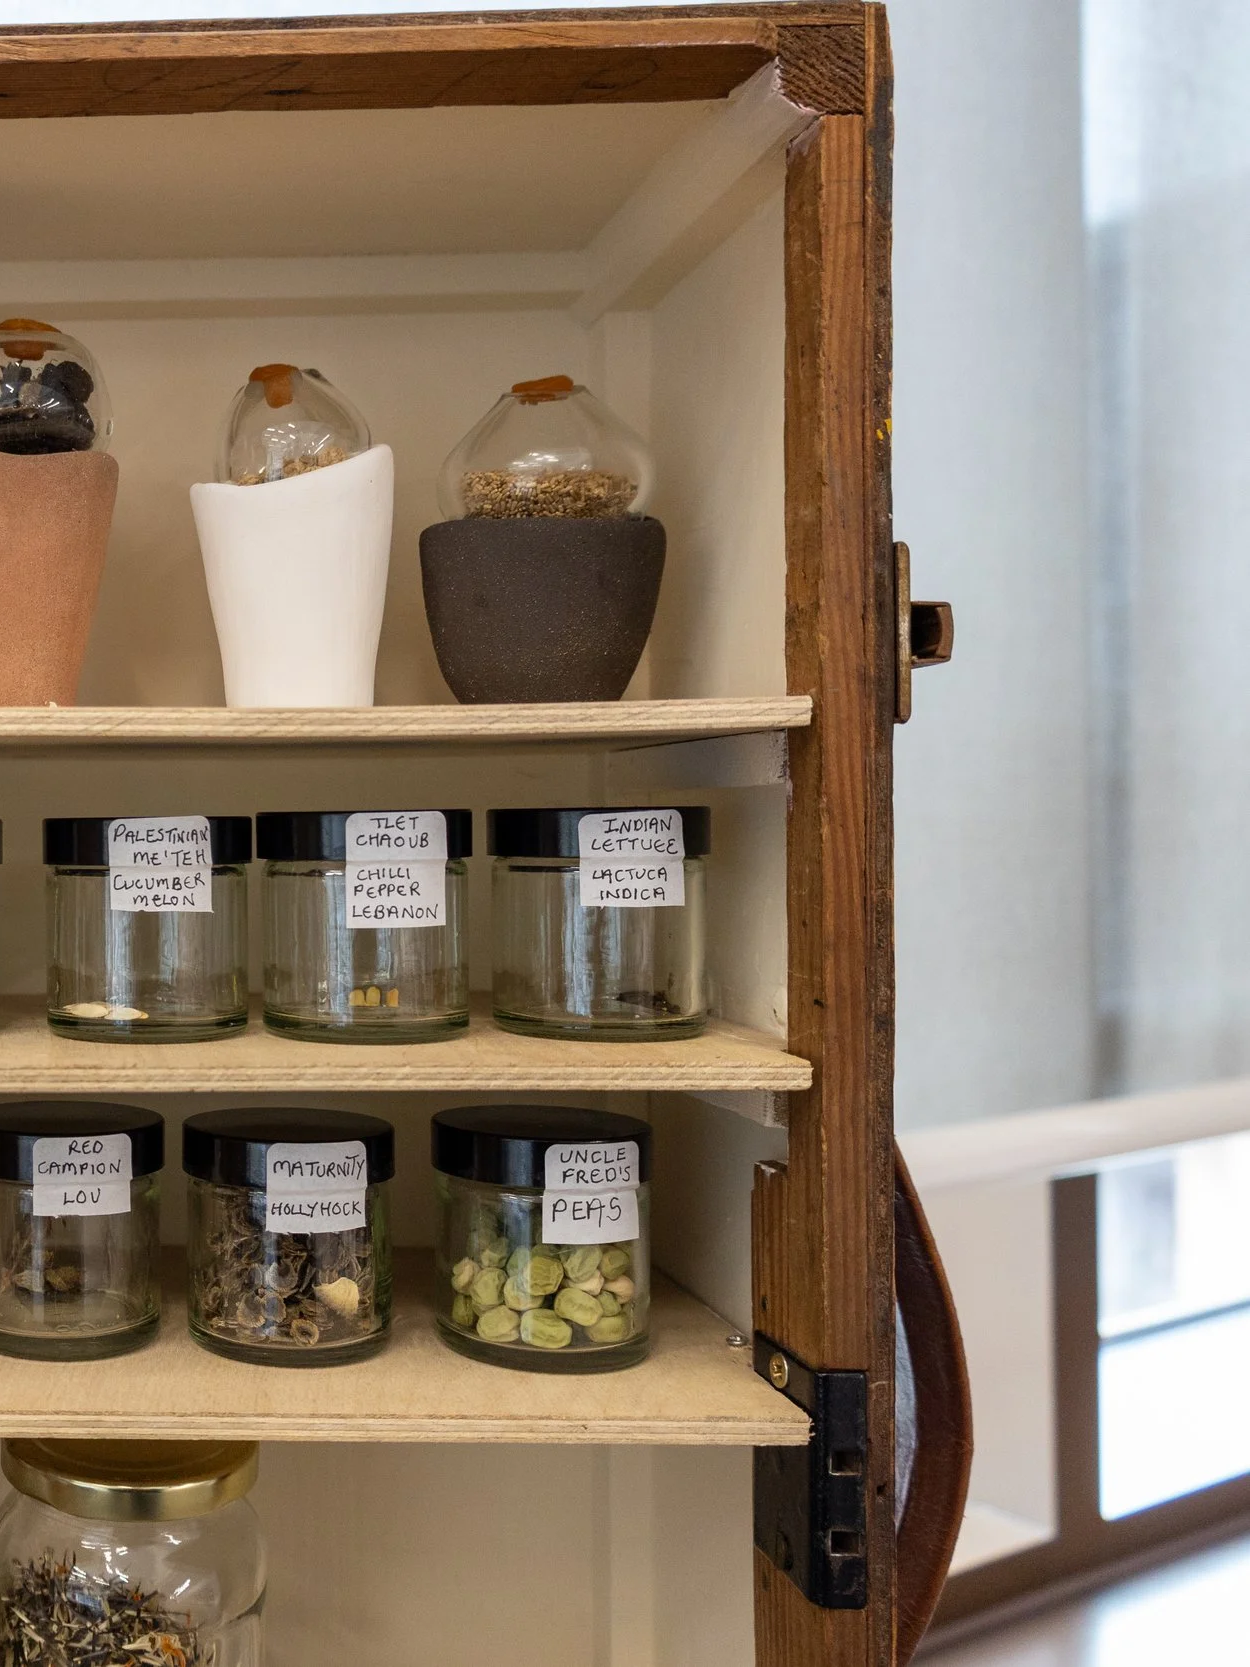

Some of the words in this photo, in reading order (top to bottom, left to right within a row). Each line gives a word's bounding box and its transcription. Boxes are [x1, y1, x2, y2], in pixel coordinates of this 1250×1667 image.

[370, 815, 419, 830] TLET
[603, 815, 672, 834] INDIAN
[113, 823, 209, 844] PALESTINIAN
[355, 832, 429, 848] CHAOUB
[133, 849, 207, 867] ME'TEH
[113, 872, 206, 891] CUCUMBER
[356, 867, 411, 881] CHILLI
[592, 867, 668, 884] LACTUCA
[354, 881, 421, 899] PEPPER
[600, 887, 666, 901] INDICA
[133, 893, 196, 907] MELON
[352, 904, 439, 919] LEBANON
[68, 1140, 104, 1156] RED
[560, 1147, 627, 1164] UNCLE
[37, 1159, 121, 1176] CAMPION
[273, 1154, 366, 1180] MATURNITY
[562, 1166, 631, 1184] FRED'S
[271, 1201, 362, 1218] HOLLYHOCK
[552, 1197, 622, 1228] PEAS
